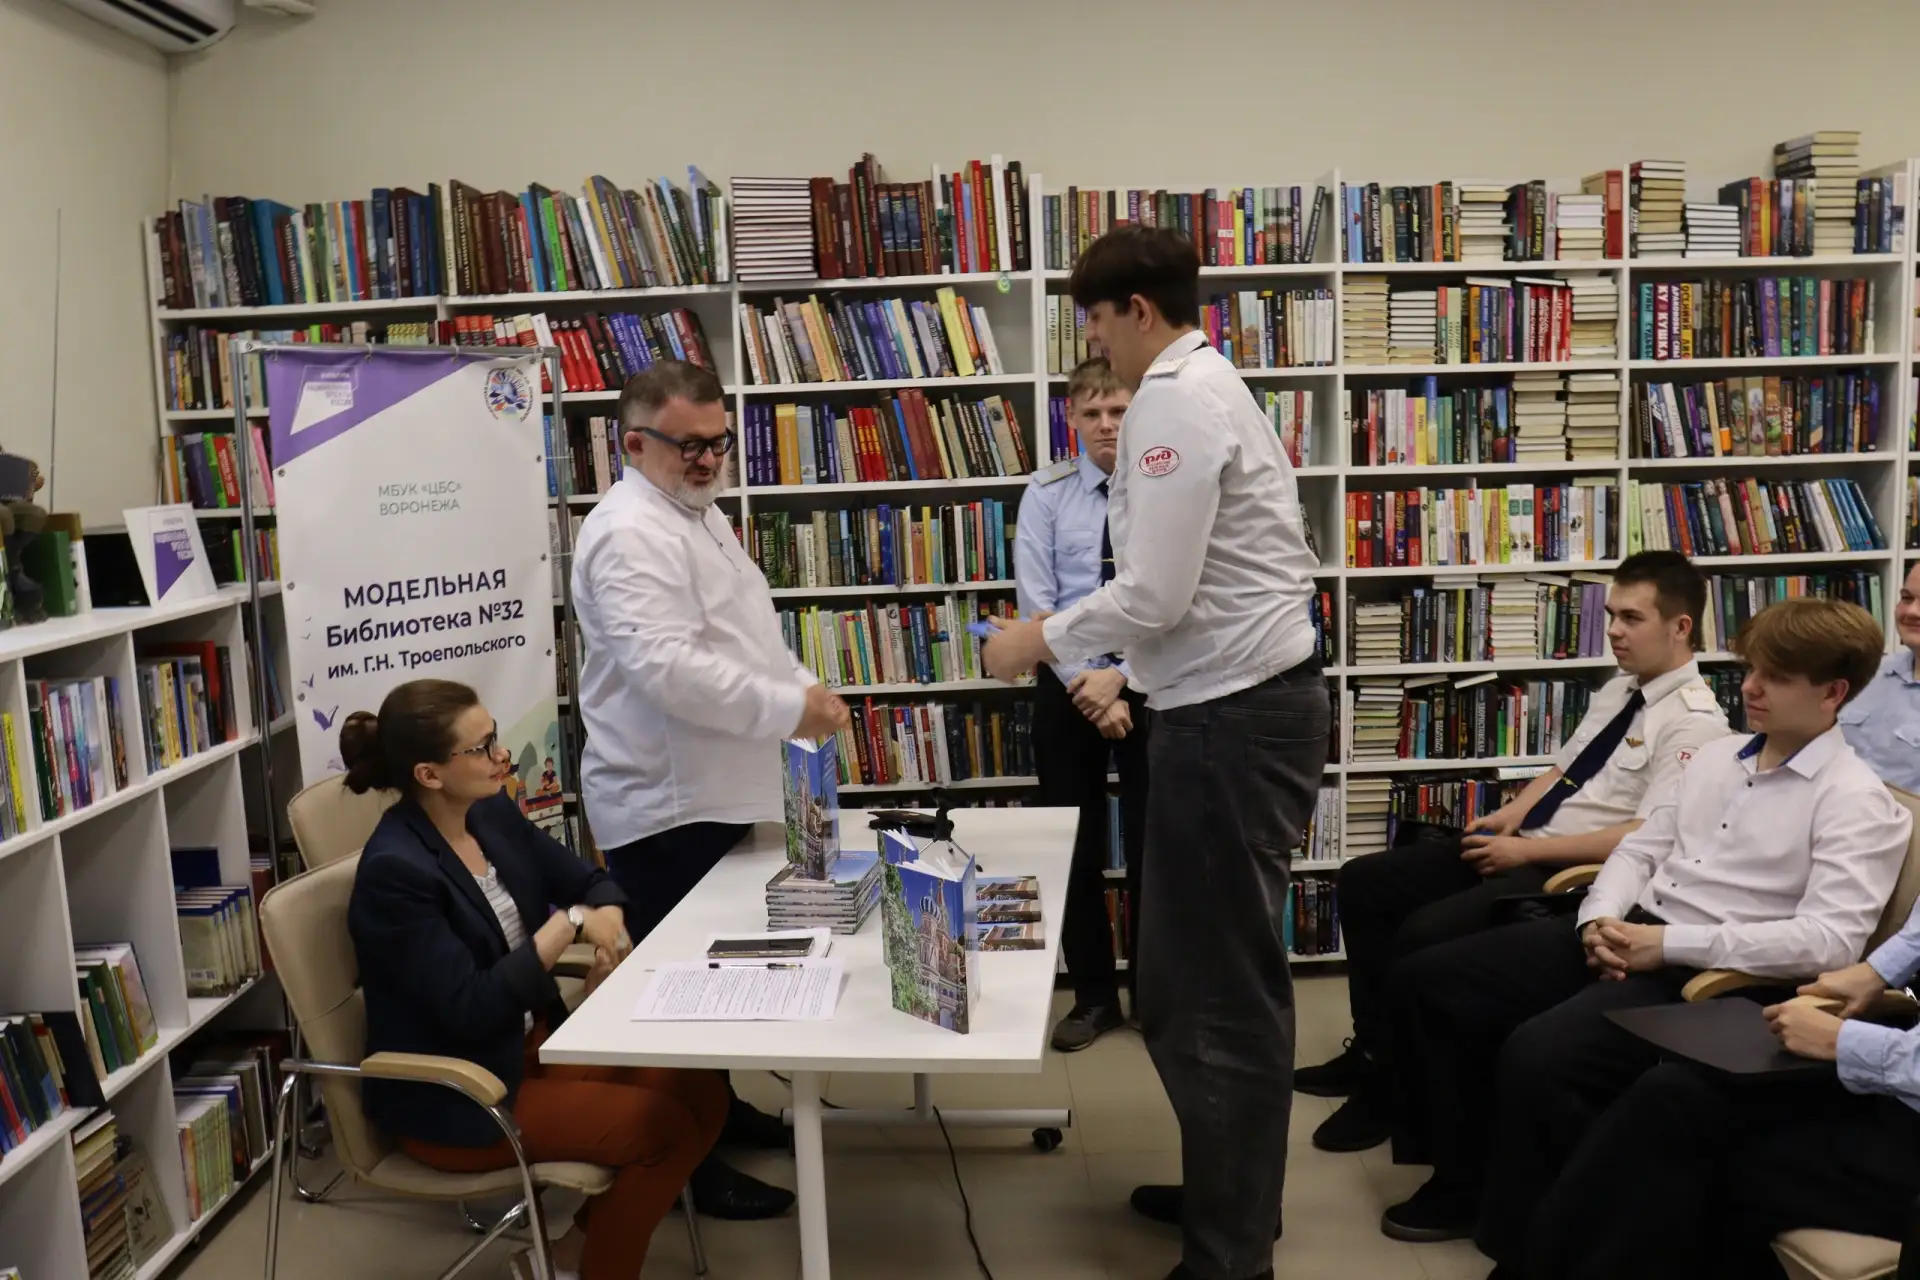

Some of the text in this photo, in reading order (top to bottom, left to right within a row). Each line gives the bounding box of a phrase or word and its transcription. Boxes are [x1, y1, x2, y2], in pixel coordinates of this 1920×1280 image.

[378, 480, 462, 498] МБУК «ЦБС»
[380, 499, 461, 516] ВОРОНЕЖА
[344, 569, 507, 609] МОДЕЛЬНАЯ
[326, 599, 524, 647] Библиотека №32
[328, 633, 526, 679] им. Г.Н. Троепольского
